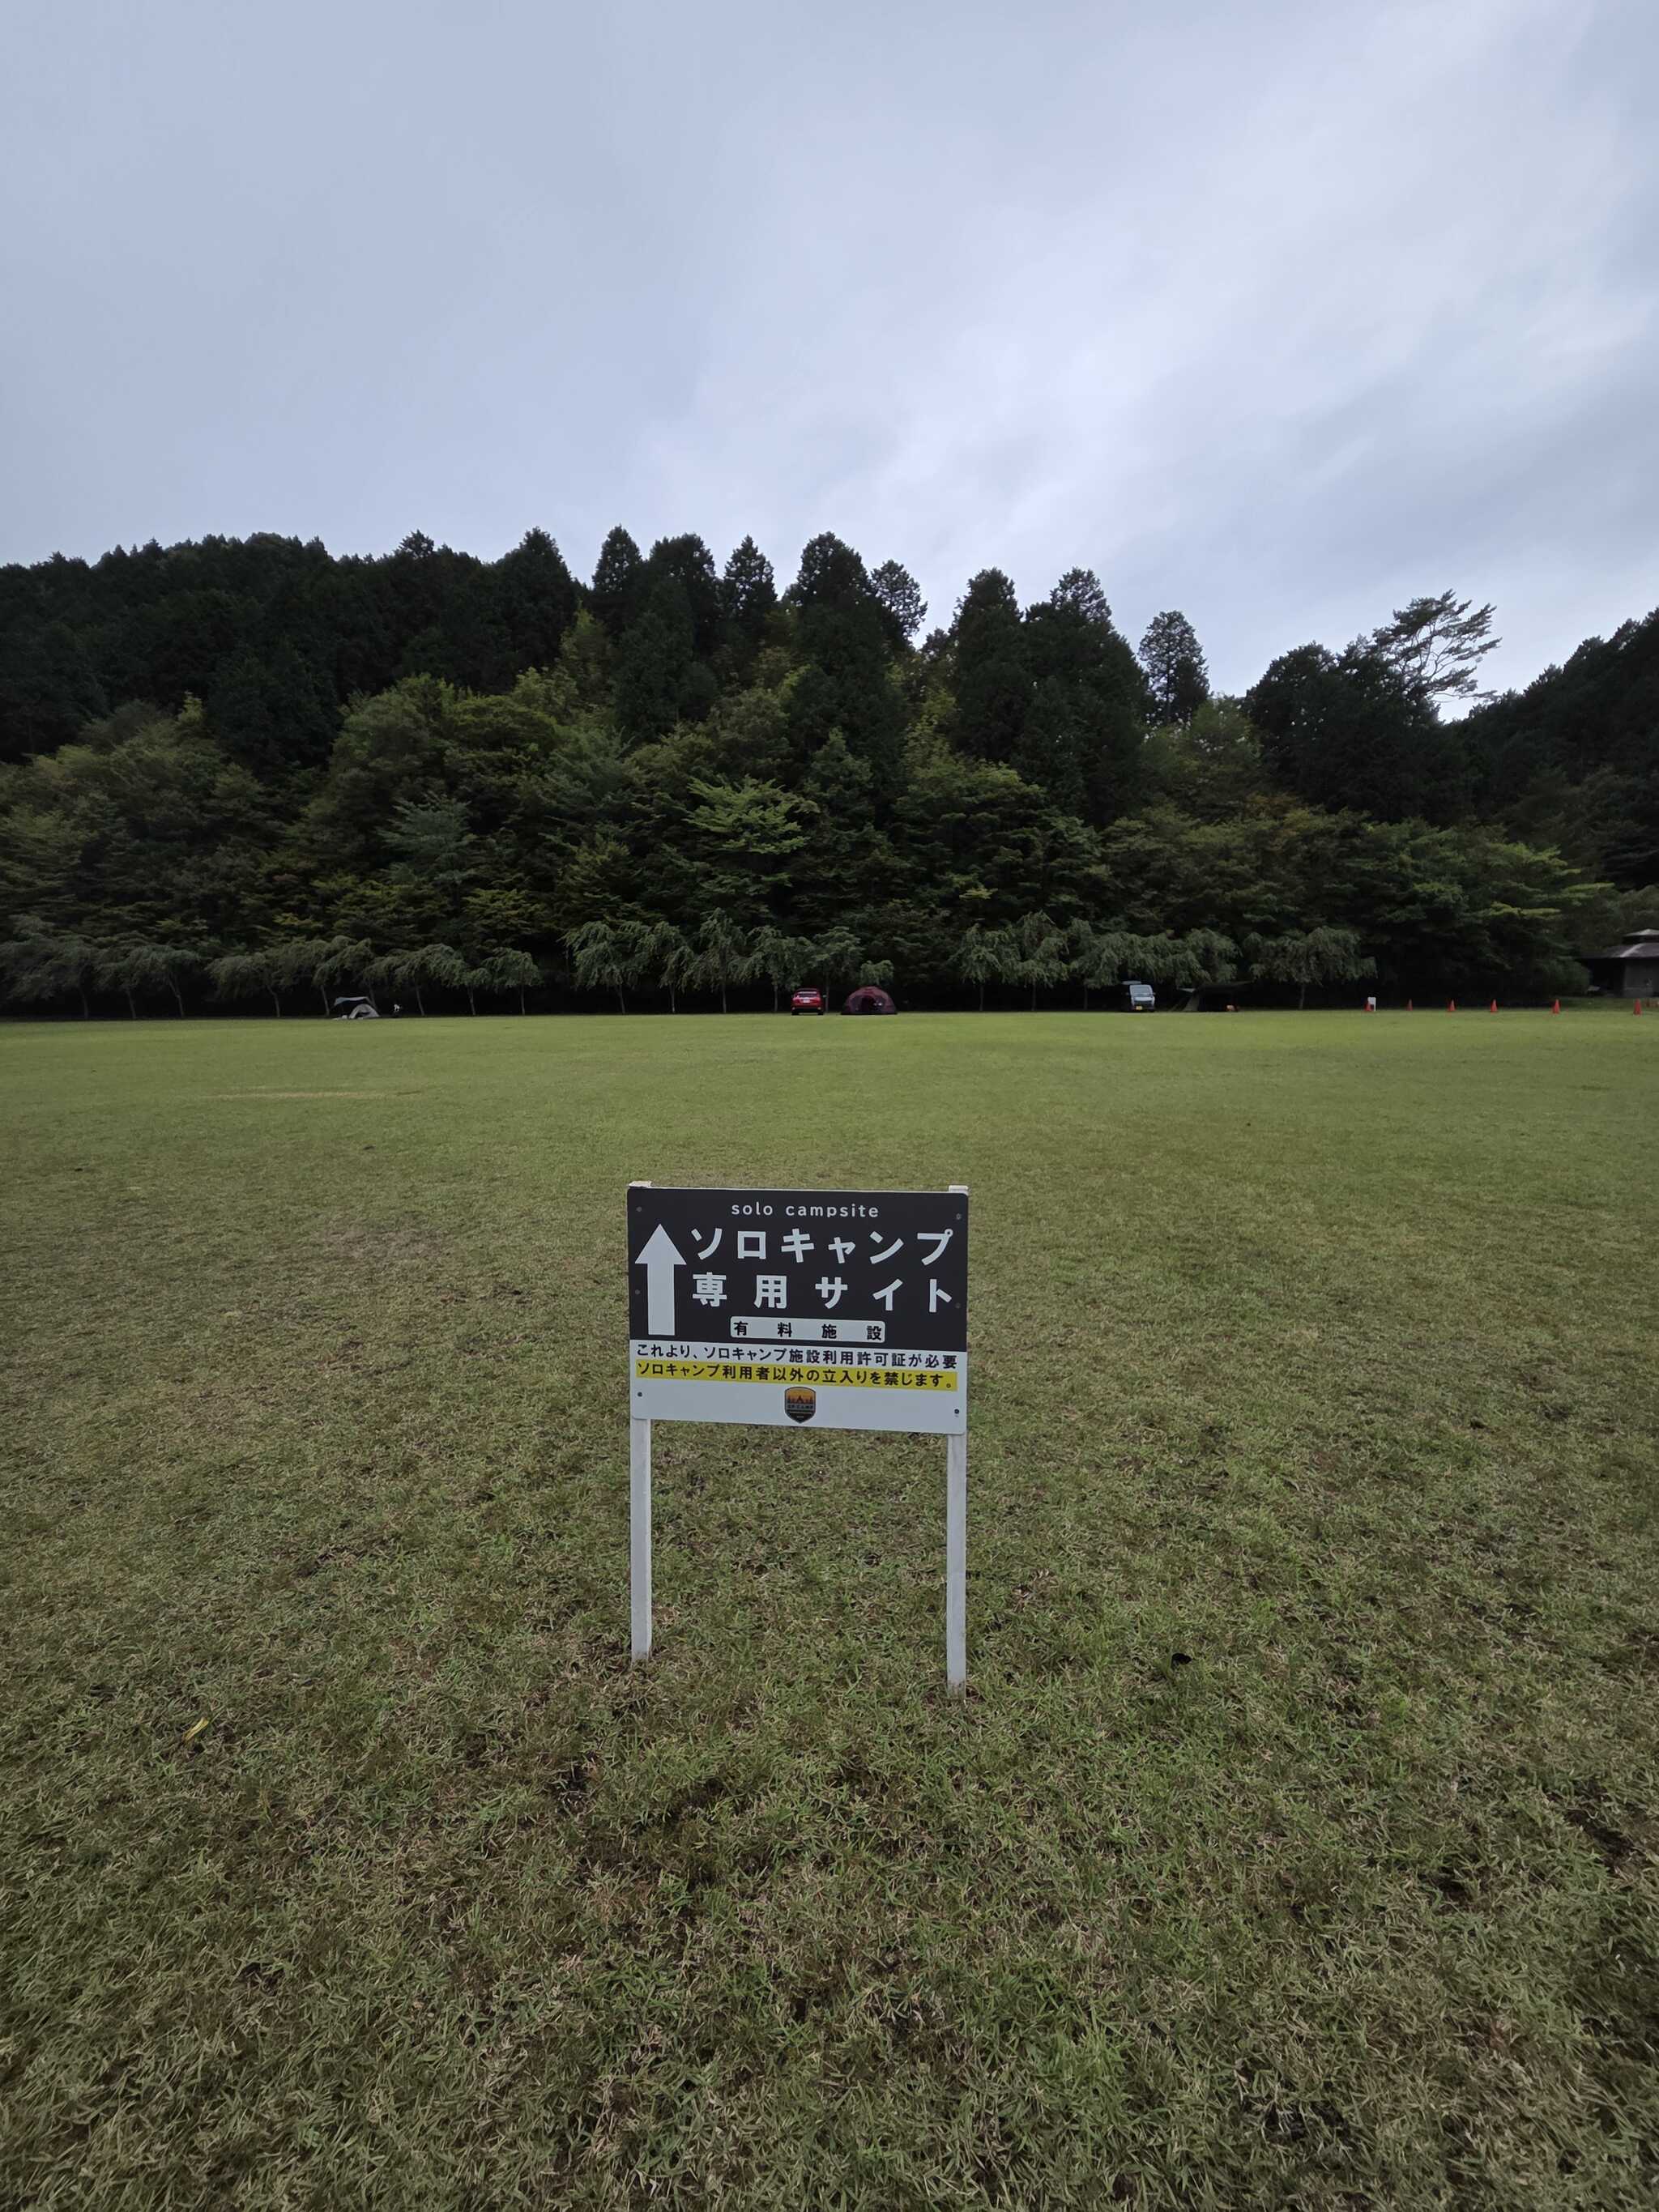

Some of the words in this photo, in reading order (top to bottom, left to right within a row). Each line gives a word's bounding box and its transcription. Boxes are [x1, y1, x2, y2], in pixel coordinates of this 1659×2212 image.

[731, 1202, 773, 1215] solo
[786, 1204, 879, 1218] campsite
[691, 1227, 953, 1265] ソロキャンプ
[692, 1272, 953, 1313] 専用サイト
[733, 1321, 883, 1341] 有料施設
